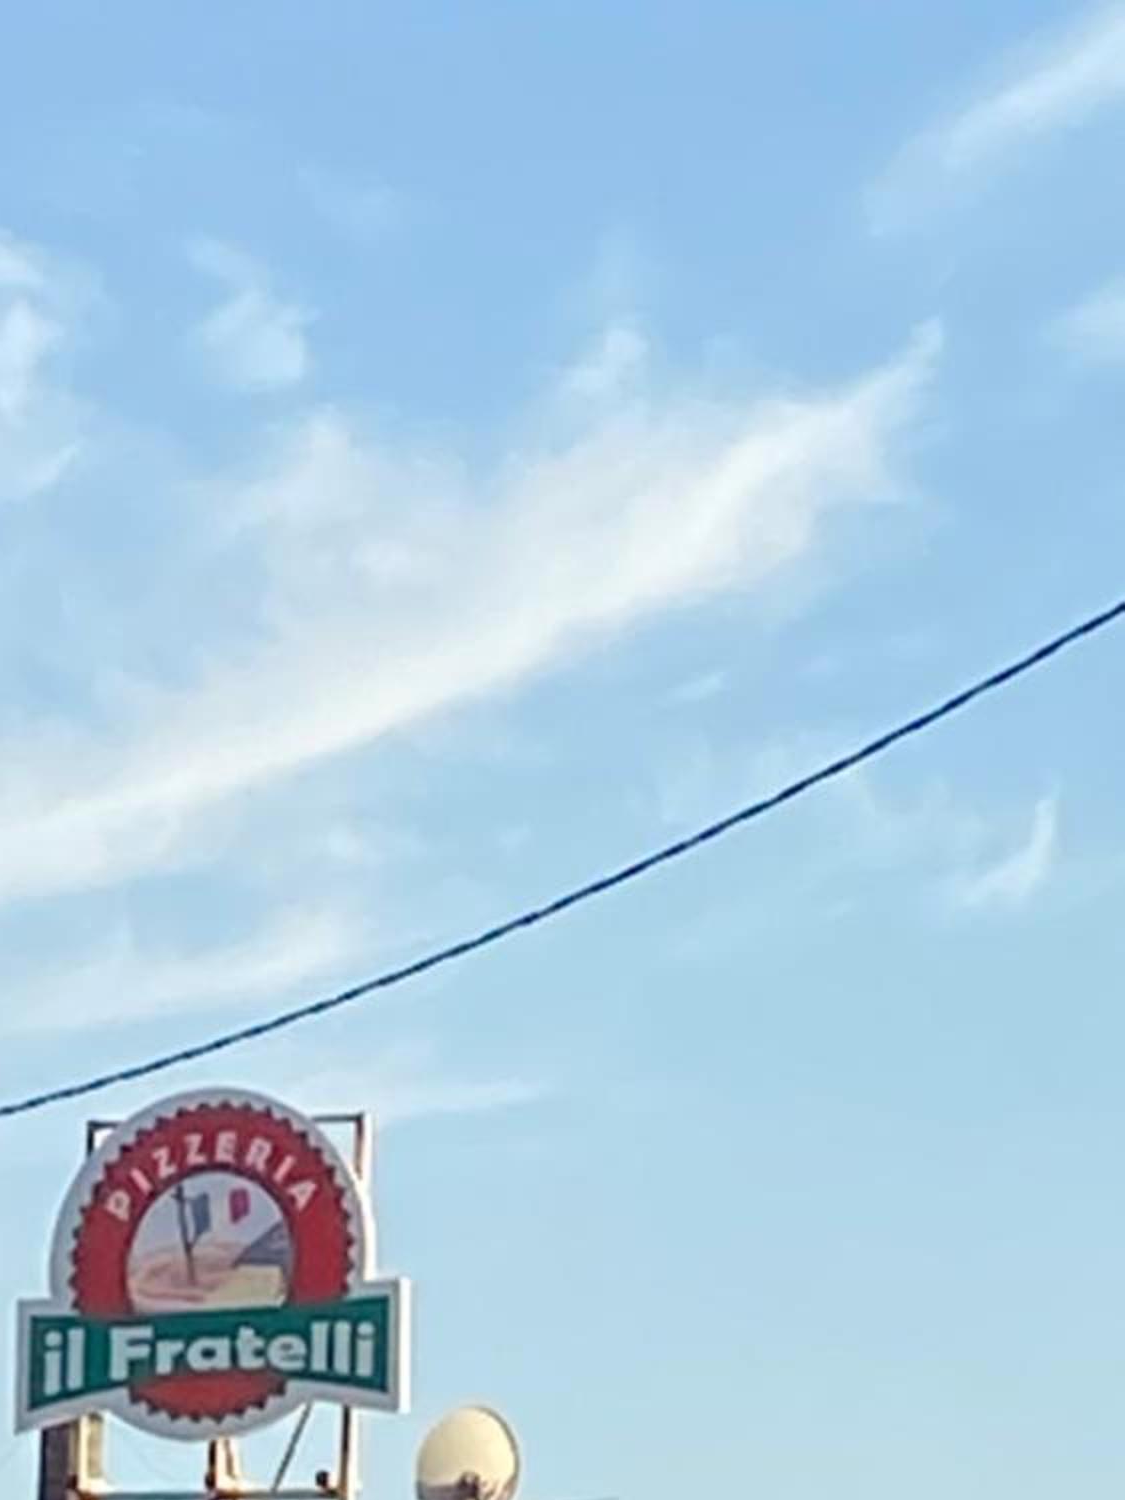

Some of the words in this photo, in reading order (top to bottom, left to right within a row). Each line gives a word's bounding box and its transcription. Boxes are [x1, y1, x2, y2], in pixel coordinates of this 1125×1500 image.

[105, 1131, 319, 1222] PIZZERIA
[43, 1328, 85, 1397] il
[109, 1321, 376, 1380] Fratelli
